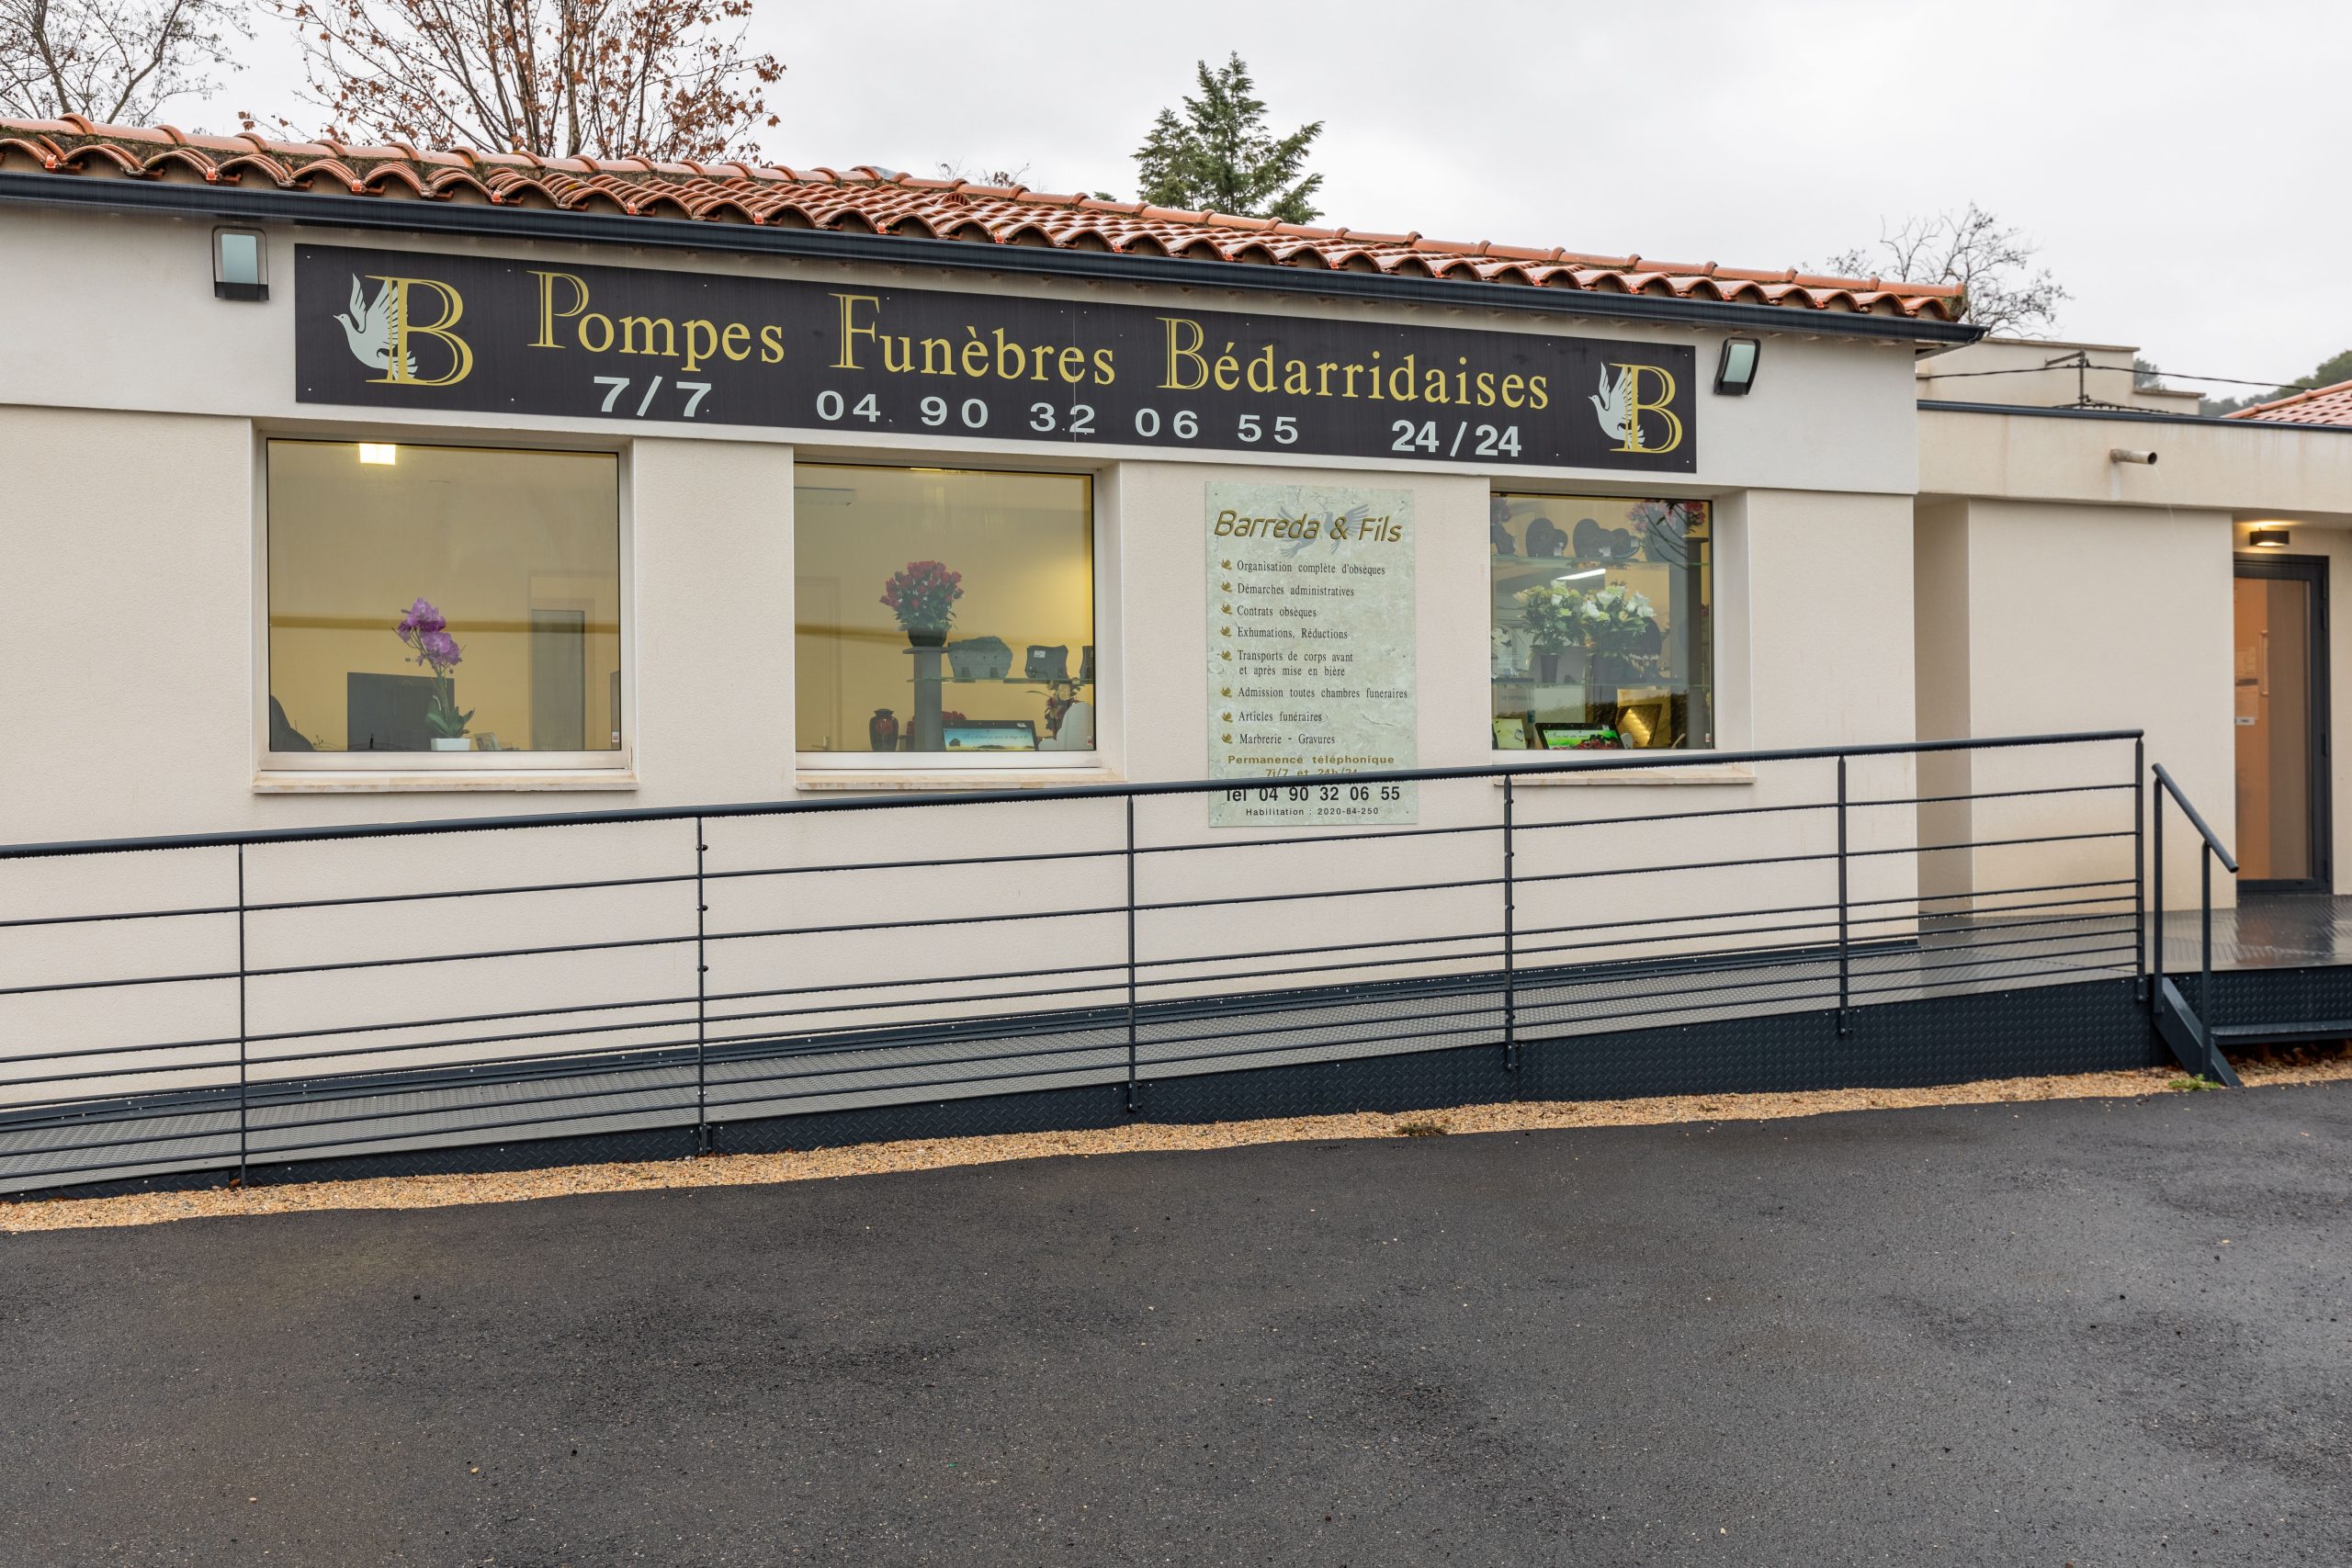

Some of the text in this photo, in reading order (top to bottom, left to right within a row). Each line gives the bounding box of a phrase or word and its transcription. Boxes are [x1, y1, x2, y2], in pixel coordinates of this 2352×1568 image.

[527, 270, 1549, 410] Pompes Funèbres Bédarridaises
[593, 376, 1522, 458] 7/7 04 90 32 06 55 24/24
[1214, 510, 1403, 542] Barreda & Fils
[1237, 559, 1385, 576] Organisation complète d'obsèques
[1238, 582, 1354, 596] Démarches administratives
[1237, 605, 1317, 619] Contrats obsèques
[1238, 626, 1348, 639] Exhumations, Réductions
[1238, 650, 1353, 663] Transports de corps avant
[1238, 667, 1247, 675] et
[1253, 666, 1275, 677] après
[1283, 666, 1302, 676] mise
[1324, 666, 1345, 676] bière
[1238, 687, 1283, 698] Admission
[1290, 689, 1315, 698] toutes
[1321, 688, 1360, 698] chambres
[1238, 712, 1273, 722] Articles
[1239, 734, 1282, 744] Marbrerie
[1298, 734, 1335, 745] Gravures
[1227, 755, 1303, 764] Permanence
[1259, 787, 1278, 801] 04
[1289, 787, 1309, 801] 90
[1319, 786, 1339, 801] 32
[1350, 786, 1369, 801] 06
[1381, 785, 1400, 800] 55
[1246, 807, 1305, 816] Habilitation
[1317, 807, 1379, 816] 2020-84-250
